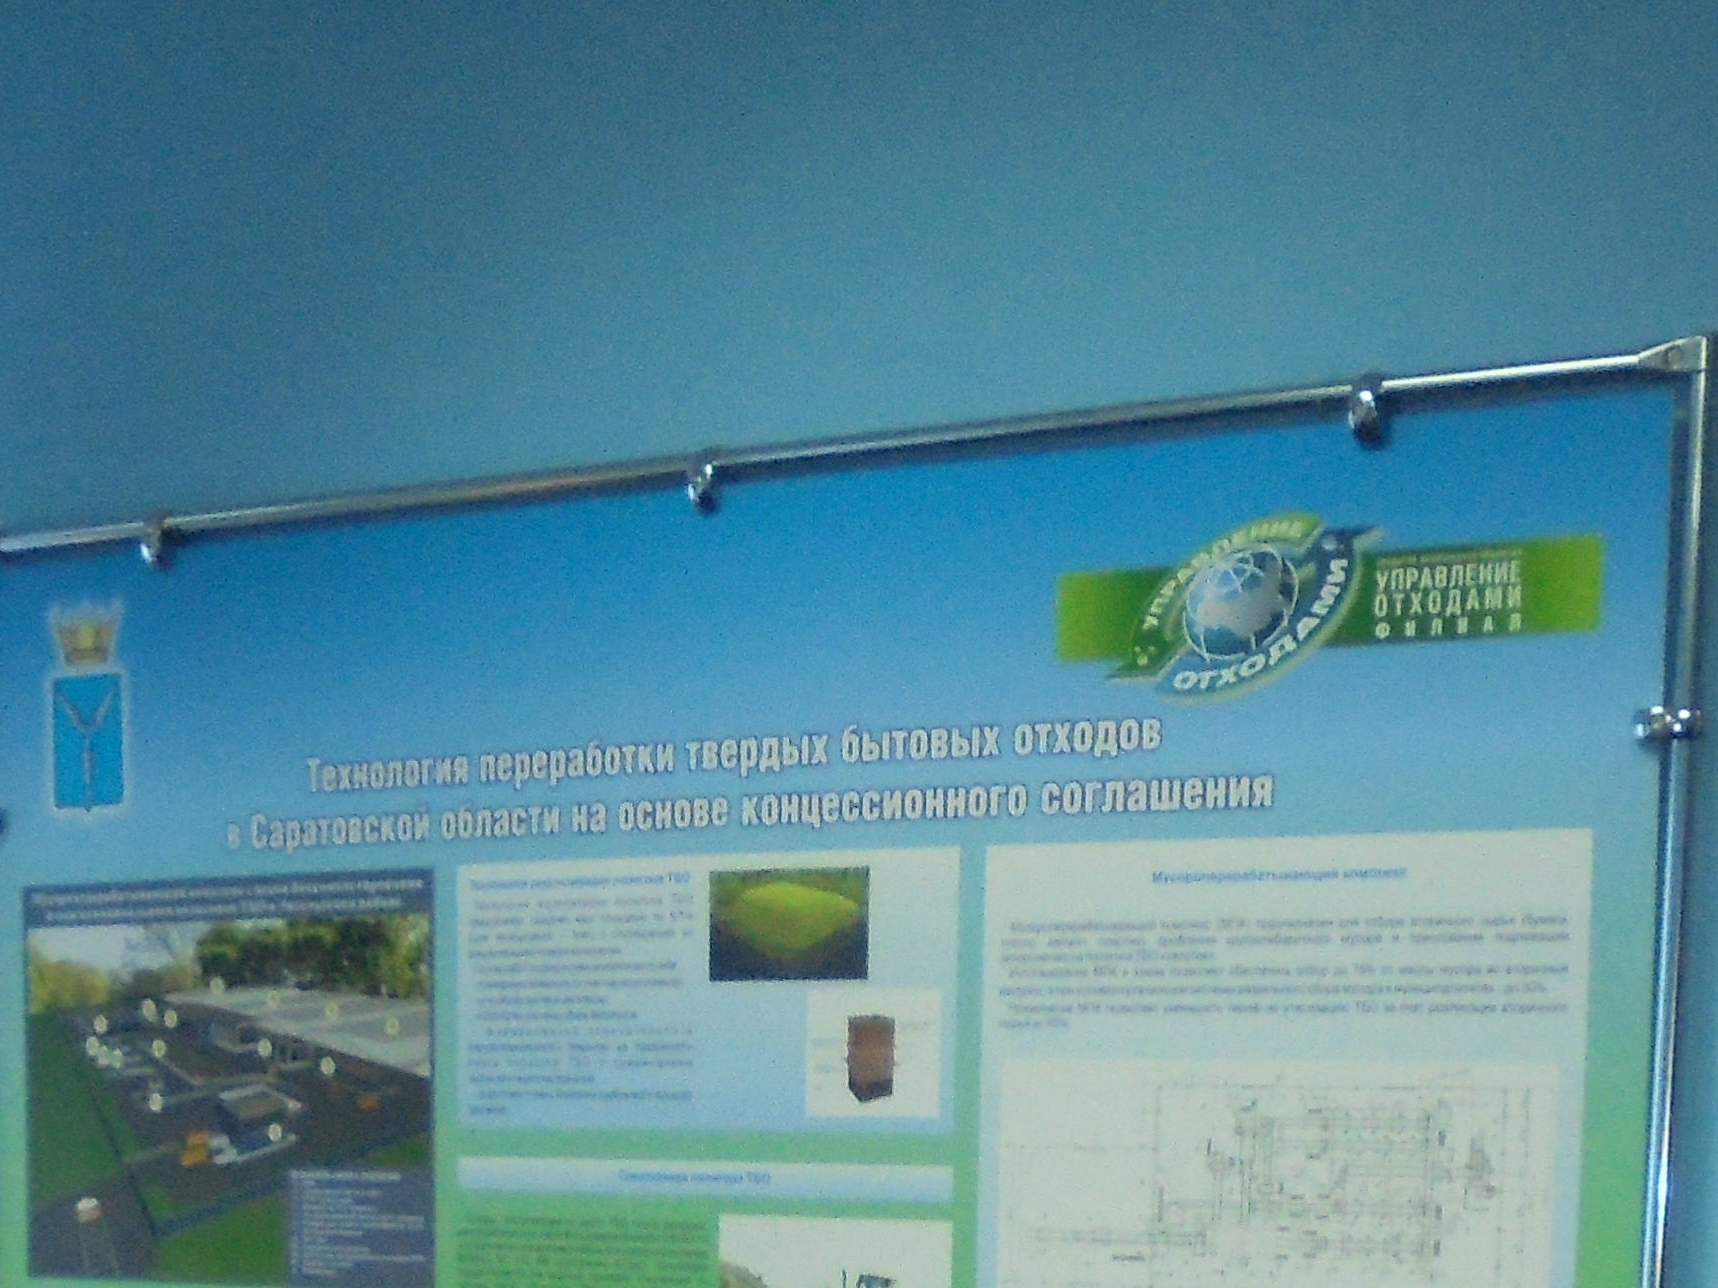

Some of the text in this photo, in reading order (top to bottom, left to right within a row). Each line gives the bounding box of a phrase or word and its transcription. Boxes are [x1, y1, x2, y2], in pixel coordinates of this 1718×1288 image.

[1376, 560, 1522, 592] УПРАВЛЕНИЕ
[1375, 585, 1522, 617] ОТХОДАМИ
[1375, 612, 1522, 639] ФИЛИАЛ
[306, 717, 1163, 793] Технология переработки твердых бытовых отходов
[227, 773, 1274, 855] в Саратовской области на основе концессионного соглашения
